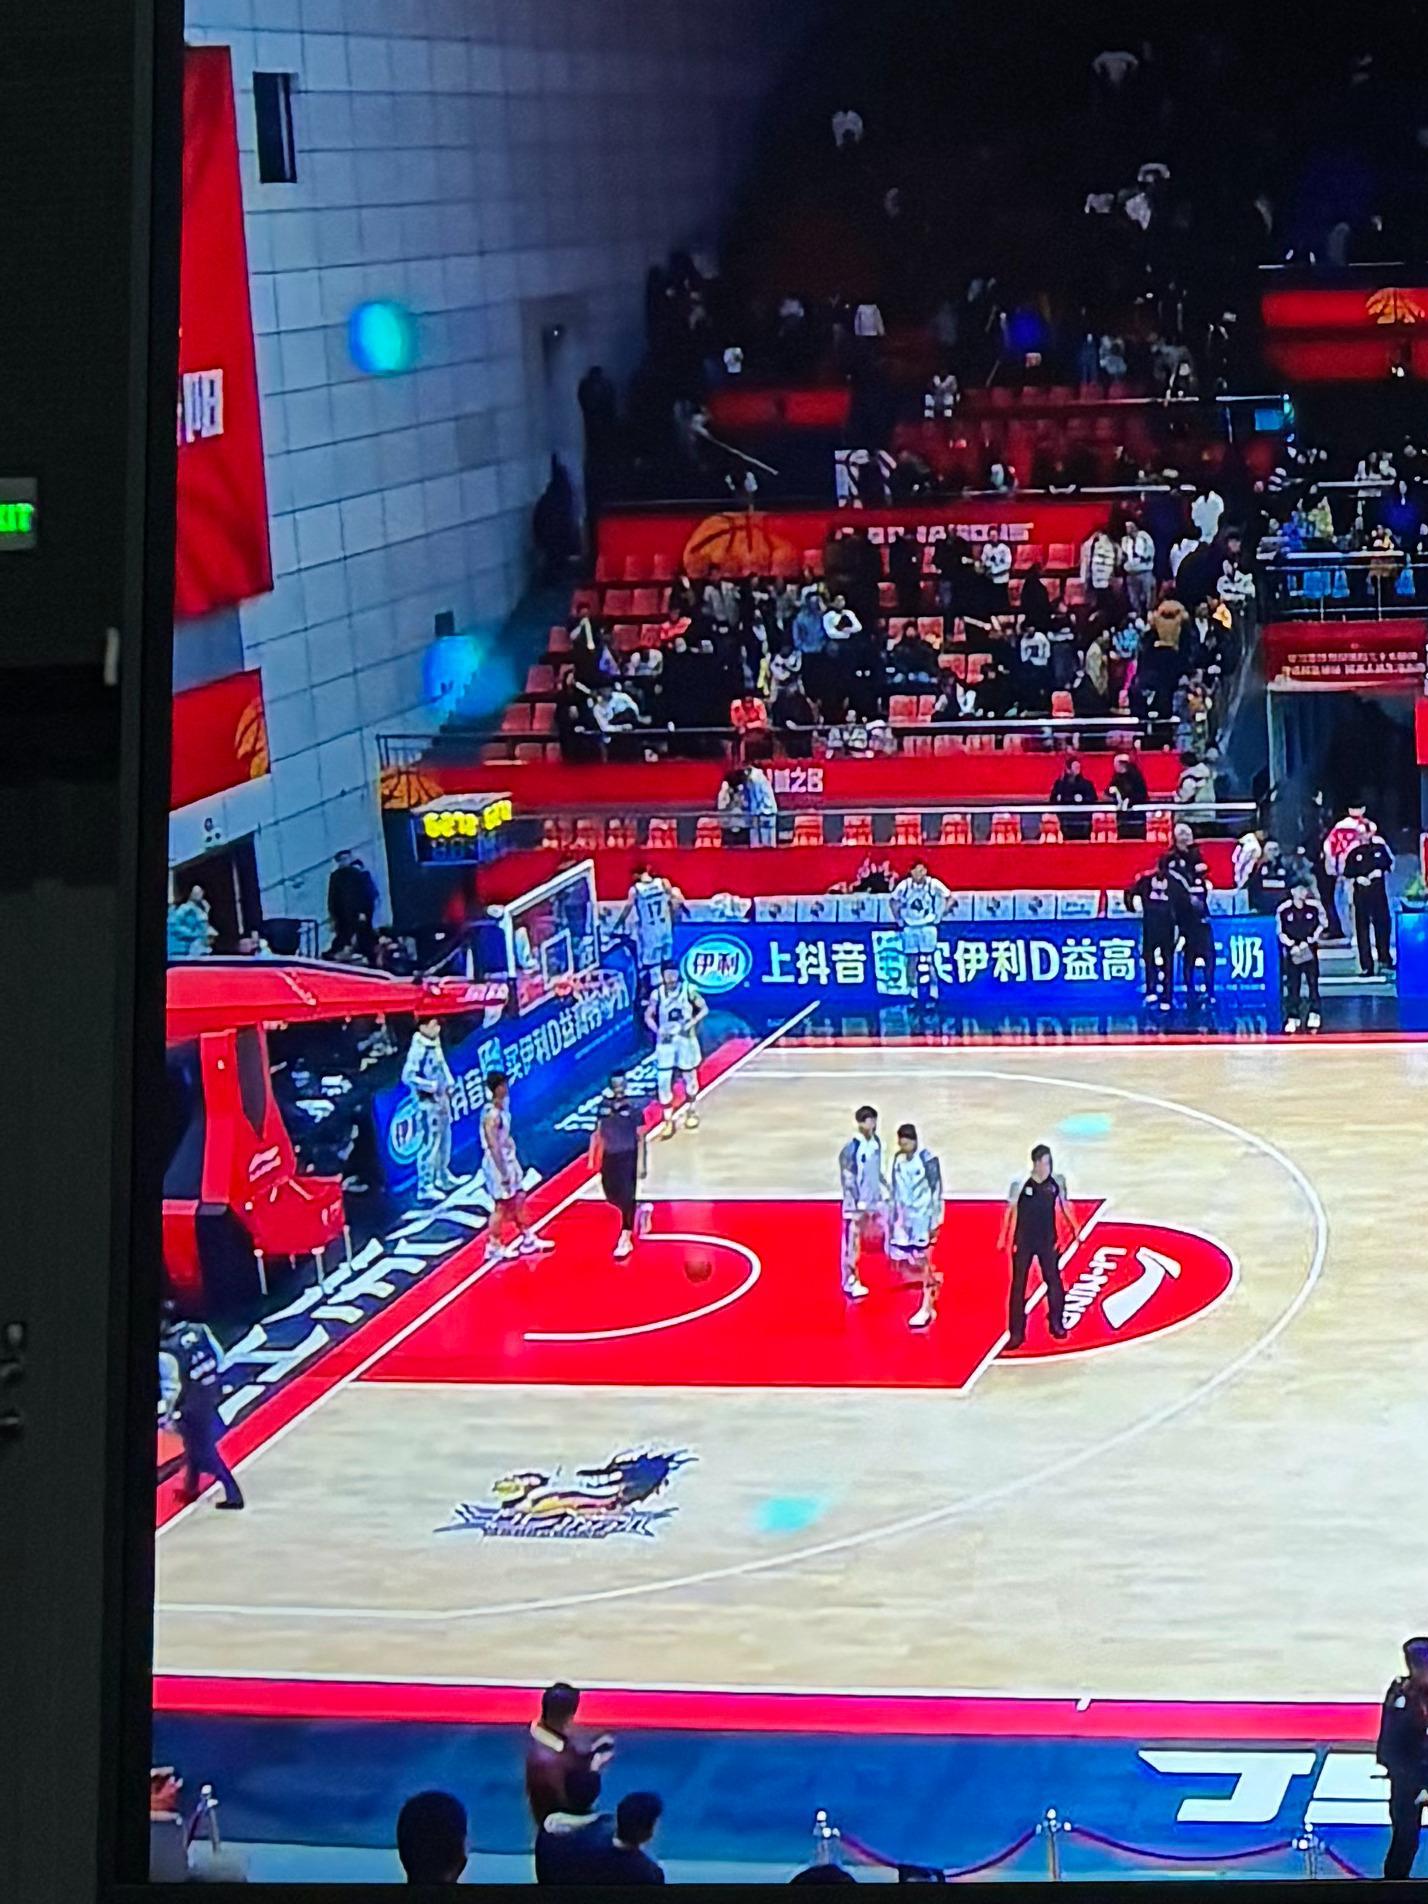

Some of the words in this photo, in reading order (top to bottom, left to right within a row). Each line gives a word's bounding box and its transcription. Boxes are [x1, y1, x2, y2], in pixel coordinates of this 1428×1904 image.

[694, 952, 740, 977] 伊利
[762, 941, 867, 984] 上抖音
